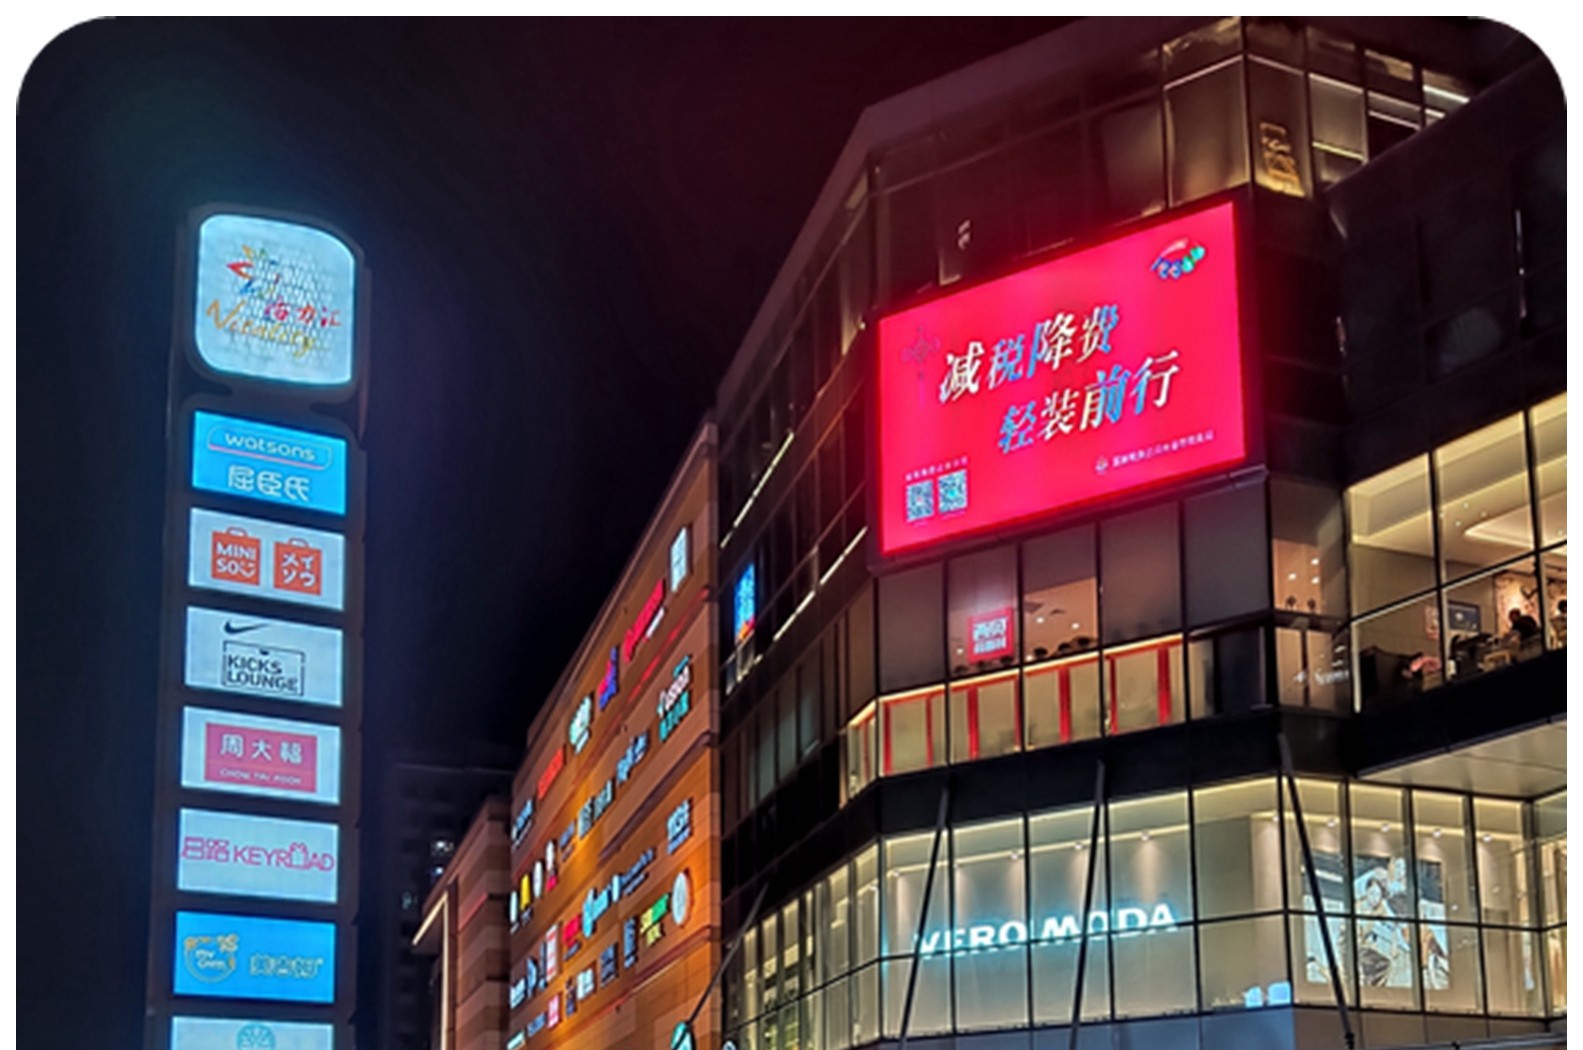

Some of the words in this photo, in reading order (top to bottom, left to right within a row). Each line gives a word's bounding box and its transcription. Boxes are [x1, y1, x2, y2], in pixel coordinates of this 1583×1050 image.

[938, 304, 1120, 405] 减税降费
[997, 350, 1180, 454] 轻装前行
[224, 432, 316, 461] watsons
[227, 463, 311, 503] 屈臣氏
[216, 541, 257, 560] MINI
[227, 653, 283, 675] KICKS
[227, 670, 299, 692] LOUNGE
[219, 733, 303, 765] 周大福
[913, 919, 1028, 960] VERO
[1040, 903, 1179, 948] MODA
